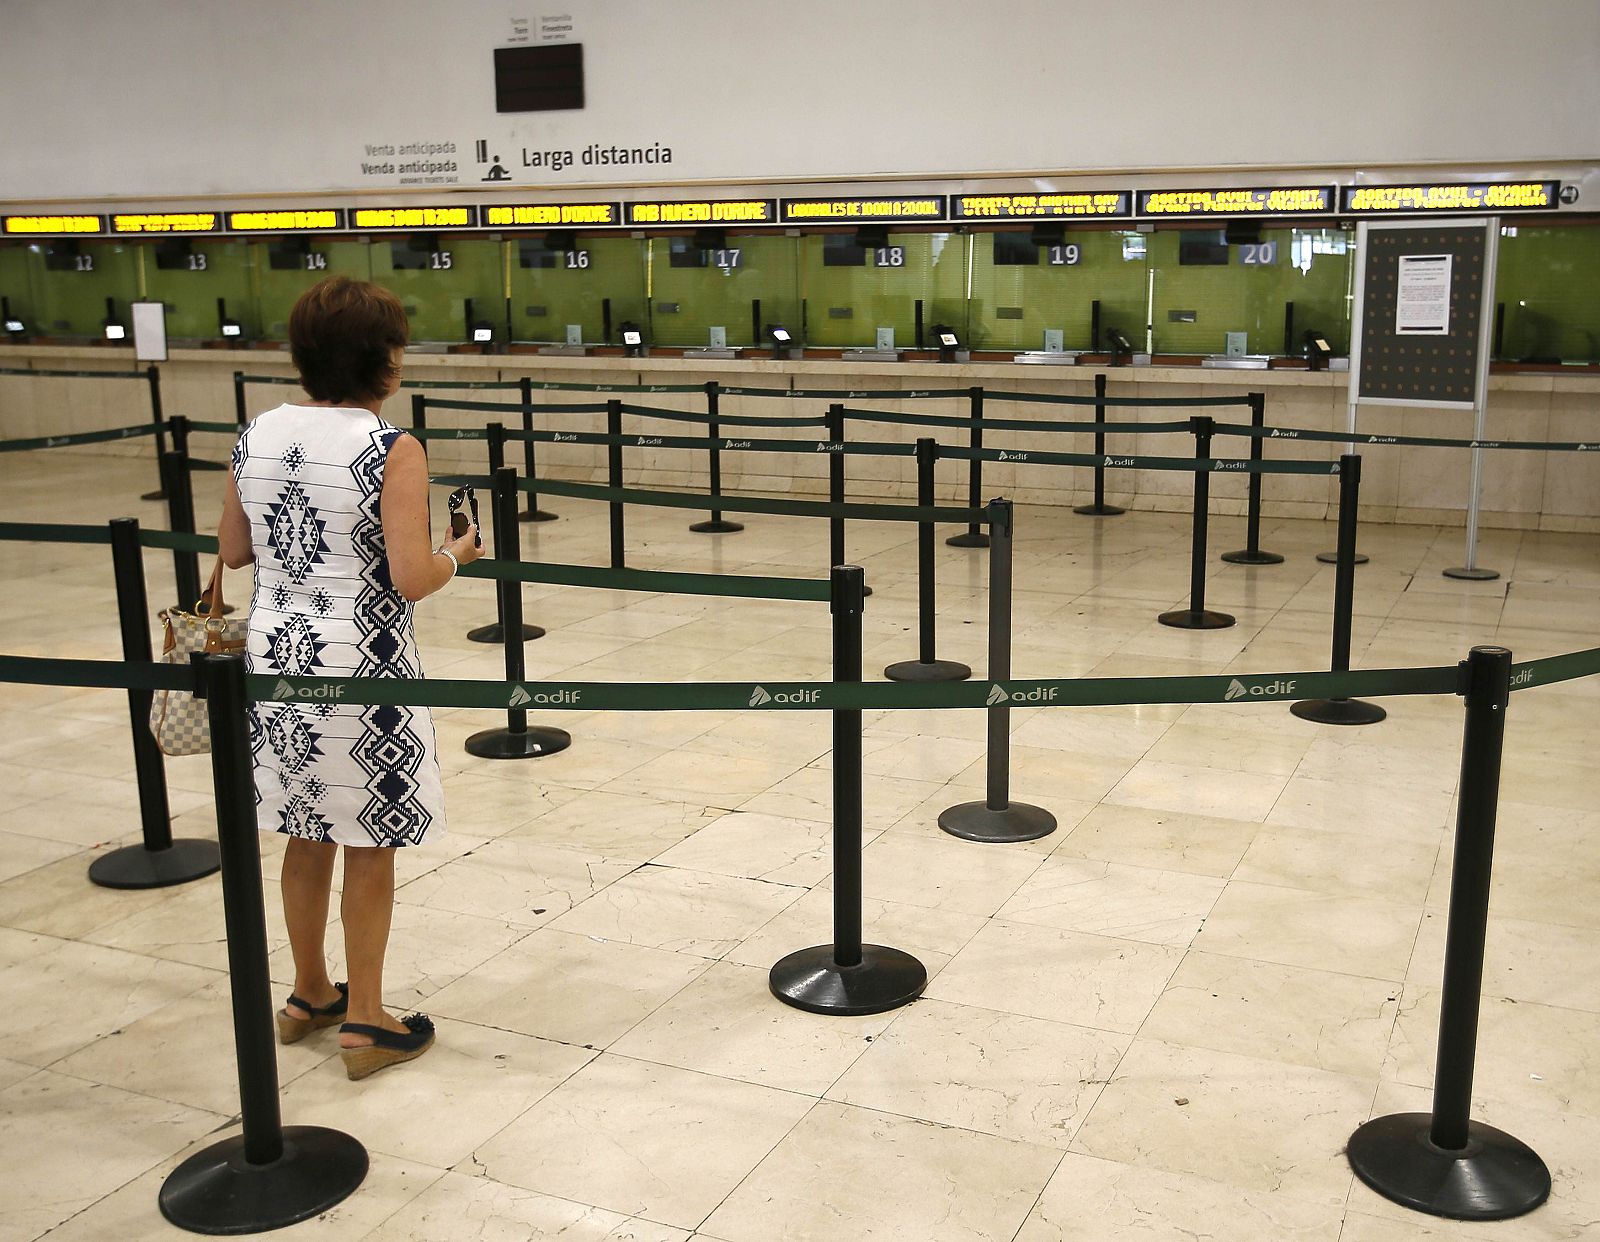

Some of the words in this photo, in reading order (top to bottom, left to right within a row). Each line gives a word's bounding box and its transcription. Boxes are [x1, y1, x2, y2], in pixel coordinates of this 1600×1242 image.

[364, 144, 395, 156] Venta
[398, 141, 457, 156] anticipada
[522, 147, 574, 171] Larga
[582, 142, 673, 167] distancia
[361, 162, 395, 175] Venda
[398, 160, 458, 175] anticipada
[306, 253, 326, 270] 14
[431, 252, 452, 270] 15
[566, 250, 589, 269] 16
[716, 249, 740, 268] 17
[877, 247, 903, 267] 18
[1051, 244, 1080, 265] 19
[1243, 243, 1273, 264] 20
[75, 255, 93, 272] 12
[188, 254, 207, 271] 13
[645, 437, 662, 445] adif
[734, 440, 751, 448] adif
[1008, 453, 1028, 461] adif
[1114, 458, 1135, 466] adif
[1225, 462, 1248, 470] adif
[298, 683, 346, 699] adif
[774, 688, 822, 703] adif
[1011, 686, 1059, 702] adif
[1250, 680, 1297, 696] adif
[533, 690, 582, 704] adif
